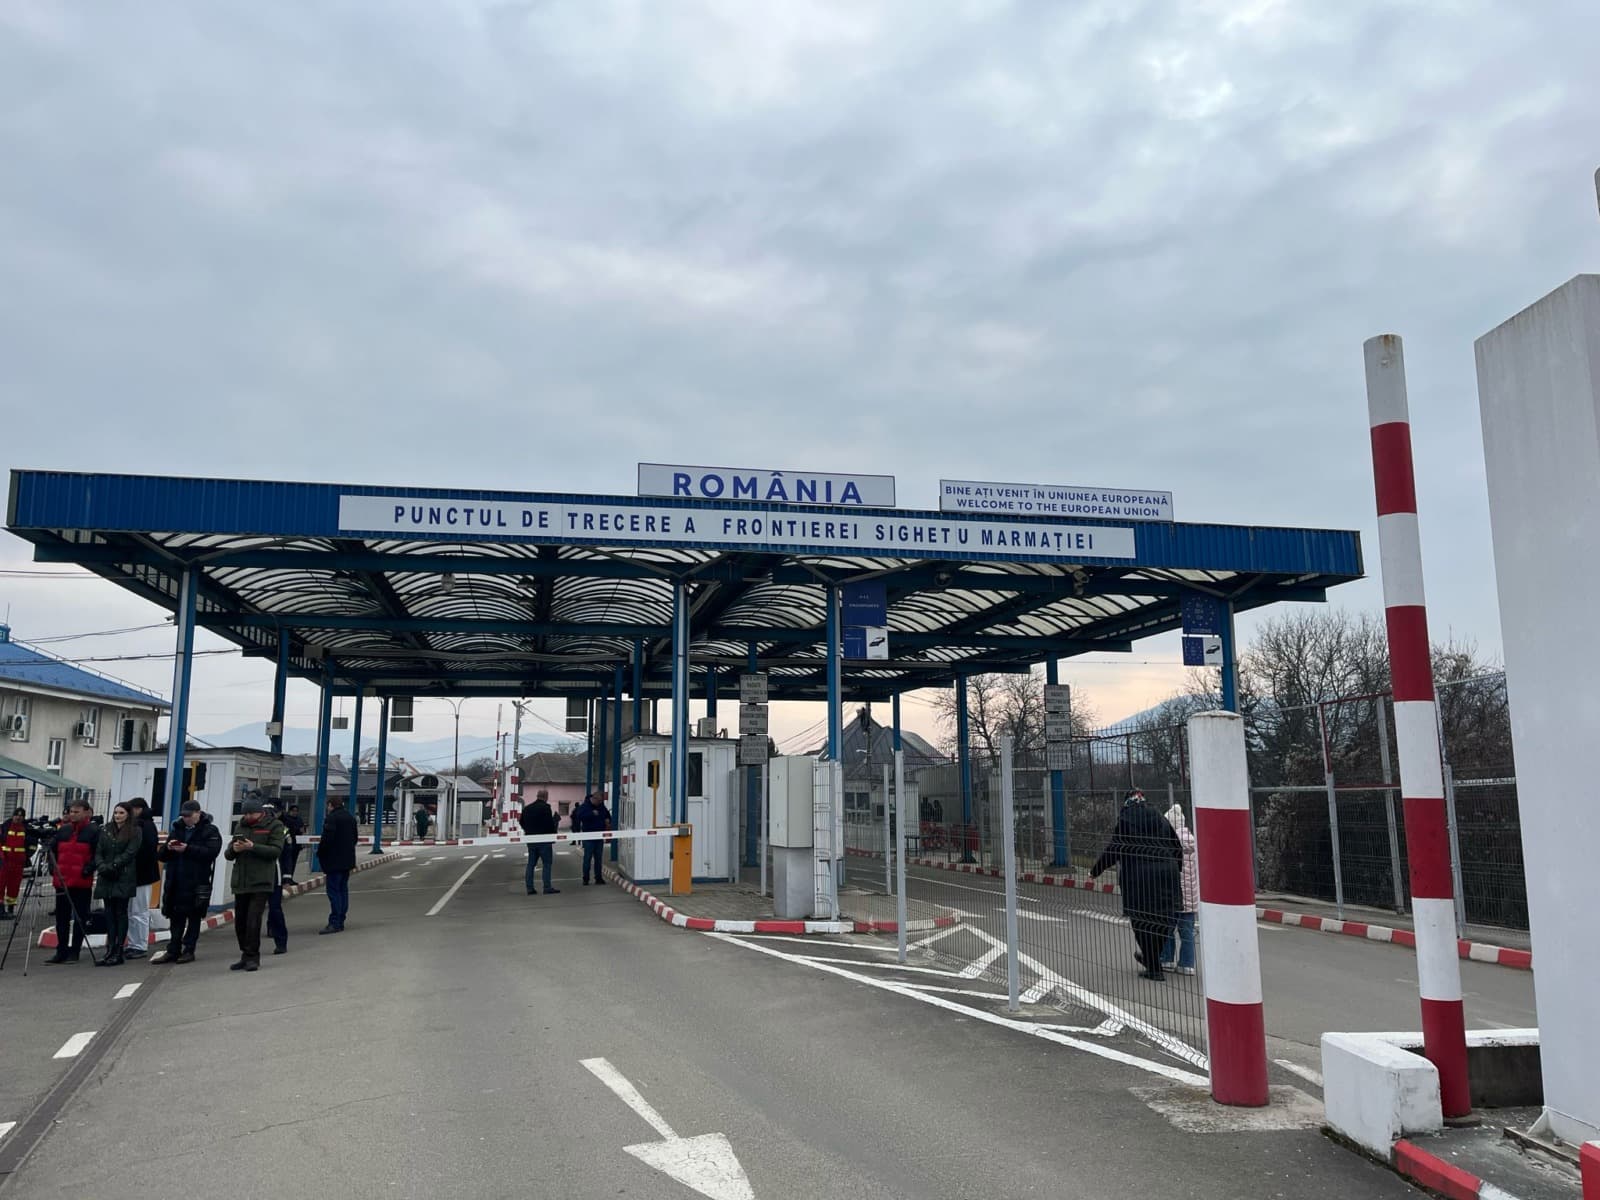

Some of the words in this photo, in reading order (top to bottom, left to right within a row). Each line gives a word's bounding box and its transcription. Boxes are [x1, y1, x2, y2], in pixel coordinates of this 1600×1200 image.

[673, 472, 864, 504] ROMÂNIA
[945, 486, 971, 496] BINE
[997, 489, 1030, 498] VENIT
[1033, 488, 1045, 499] ÎN
[1048, 491, 1098, 502] UNIUNEA
[1102, 494, 1169, 506] EUROPEANĂ
[957, 499, 1015, 510] WELCOME
[1018, 501, 1033, 511] TO
[1036, 502, 1058, 512] THE
[1061, 504, 1121, 515] EUROPEAN
[1124, 507, 1159, 517] UNION
[394, 505, 507, 527] PUNCTUL
[522, 510, 549, 529] DE
[567, 512, 671, 533] TRECERE
[684, 517, 696, 534] A
[723, 518, 858, 540] FRONTIEREI
